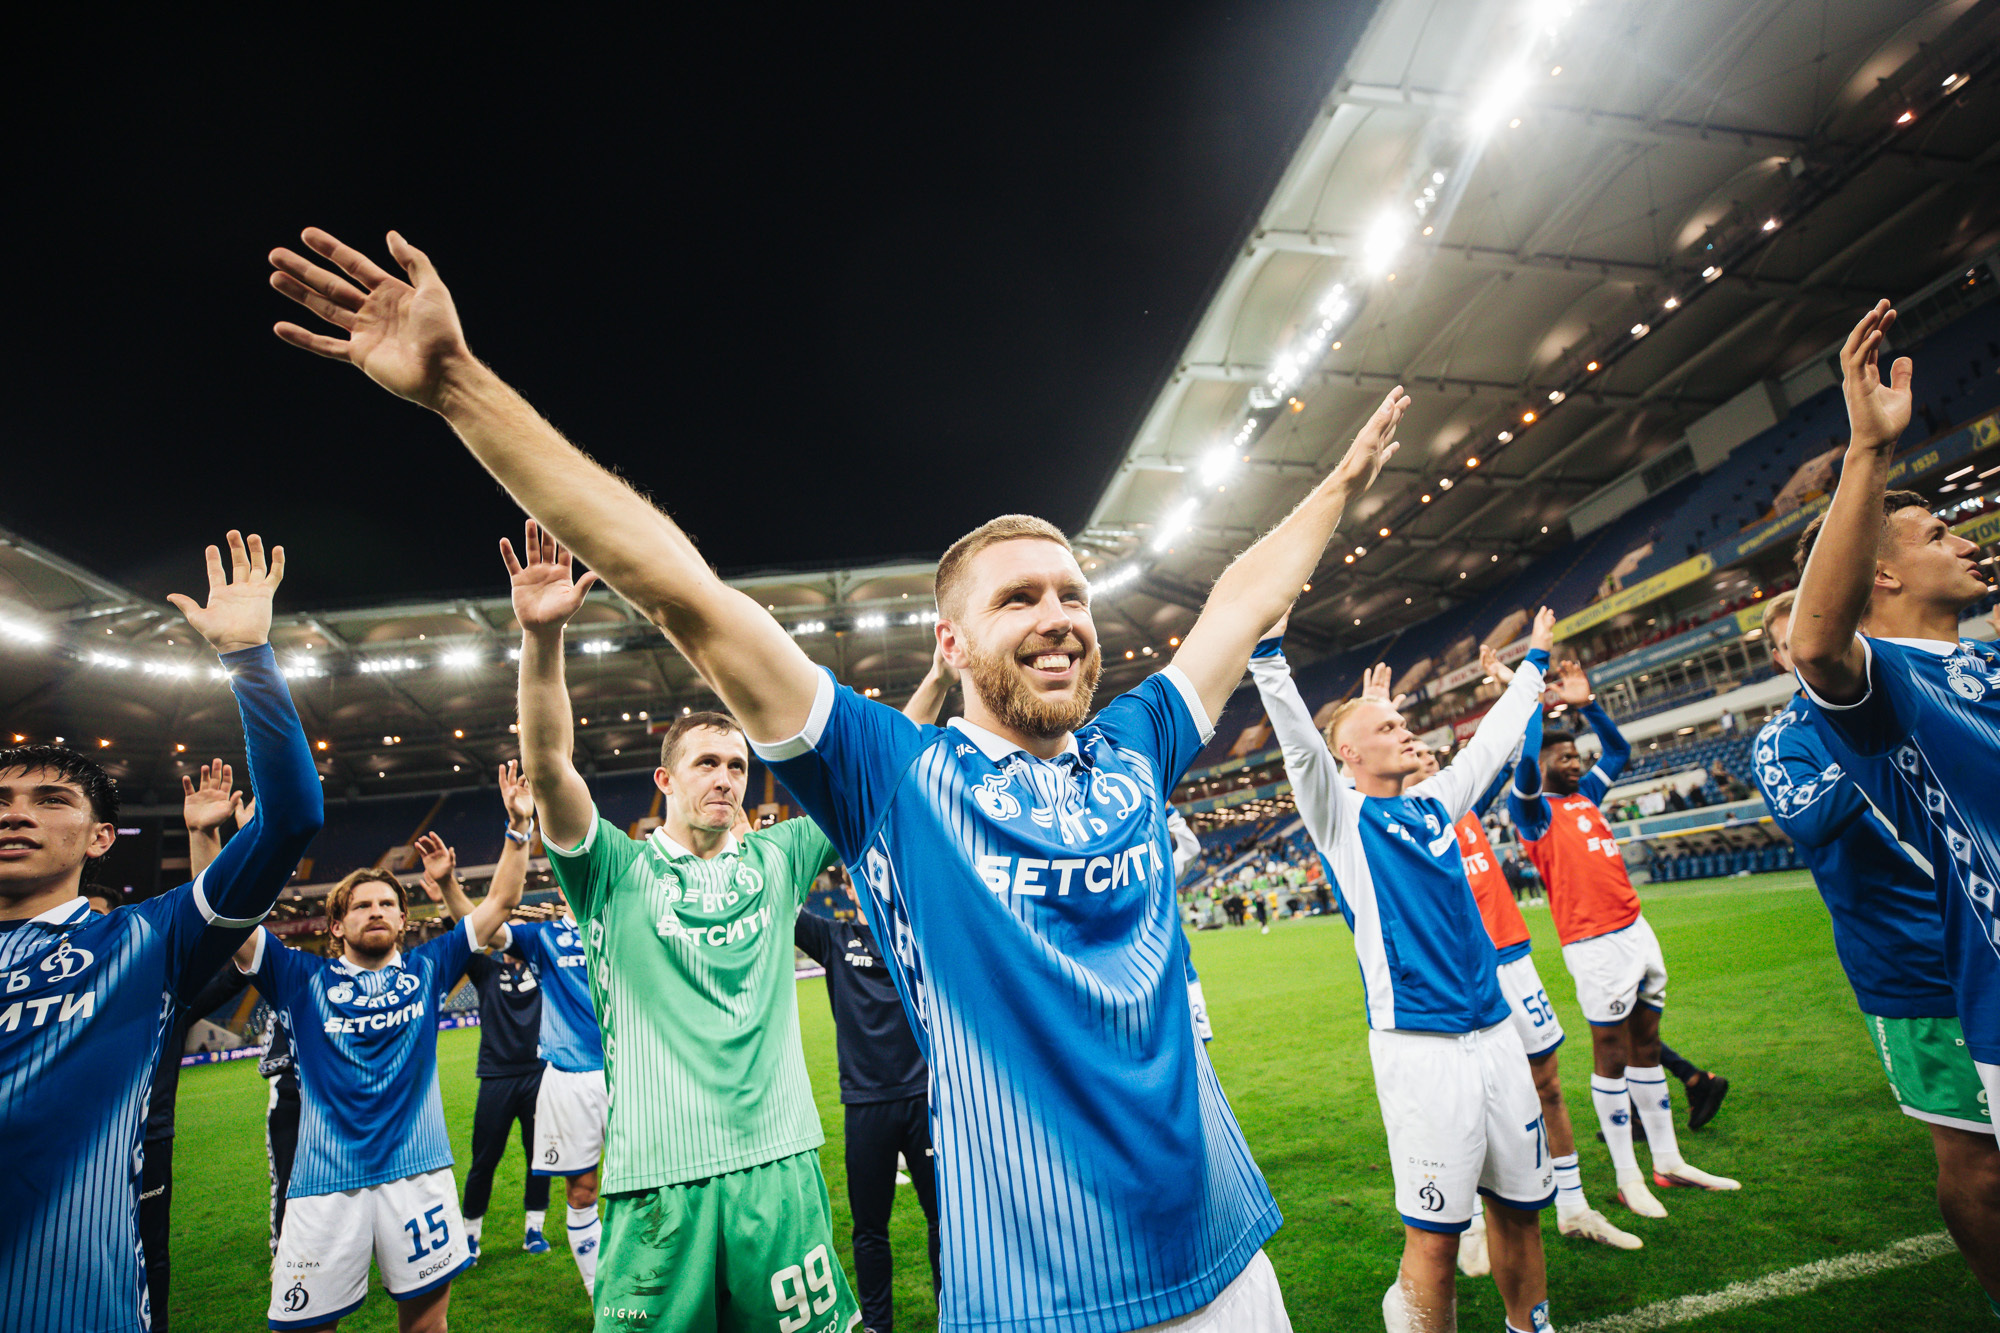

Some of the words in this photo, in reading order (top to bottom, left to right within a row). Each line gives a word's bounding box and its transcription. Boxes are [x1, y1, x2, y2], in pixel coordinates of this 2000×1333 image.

[703, 886, 739, 913] ВТБ
[1409, 1156, 1447, 1169] DIGMA
[404, 1203, 450, 1264] 15
[286, 1261, 320, 1269] DIGMA
[418, 1256, 450, 1280] BOSCO
[771, 1244, 837, 1333] 99
[603, 1306, 648, 1319] DIGMA
